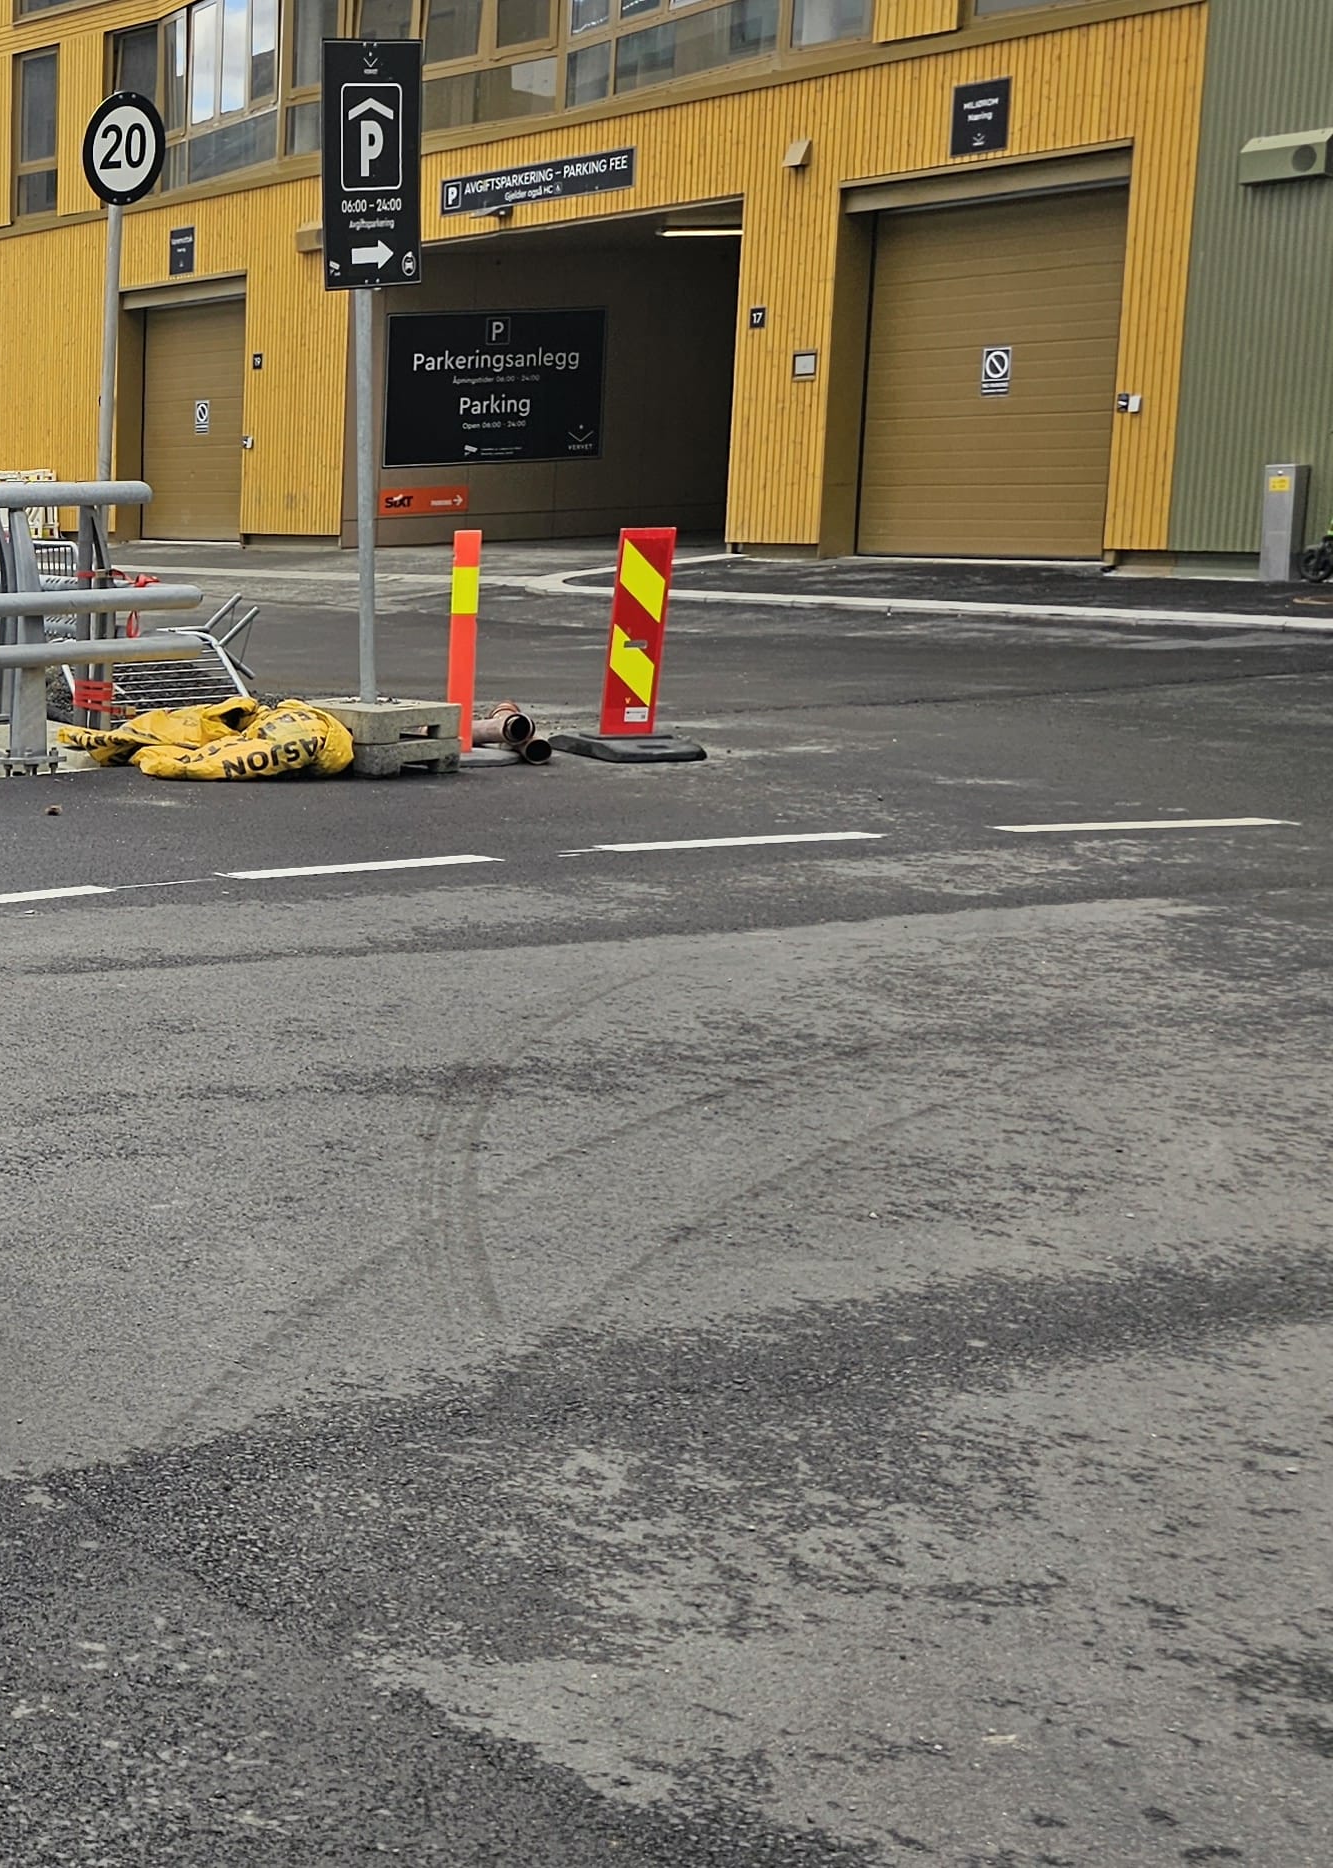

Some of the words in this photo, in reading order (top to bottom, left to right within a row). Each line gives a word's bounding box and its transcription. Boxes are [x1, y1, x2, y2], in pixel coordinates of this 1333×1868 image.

[99, 122, 147, 170] 20
[360, 120, 384, 177] P
[464, 168, 553, 195] AVGIFTSPARKERING
[562, 158, 607, 179] PARKING
[609, 154, 629, 171] FEE
[341, 199, 367, 213] 06:00
[376, 197, 402, 212] 24:00
[448, 186, 458, 205] P
[752, 312, 763, 324] 17
[491, 321, 504, 341] P
[413, 347, 580, 372] Parkeringsanlegg
[459, 394, 531, 416] Parking
[462, 422, 481, 430] Open
